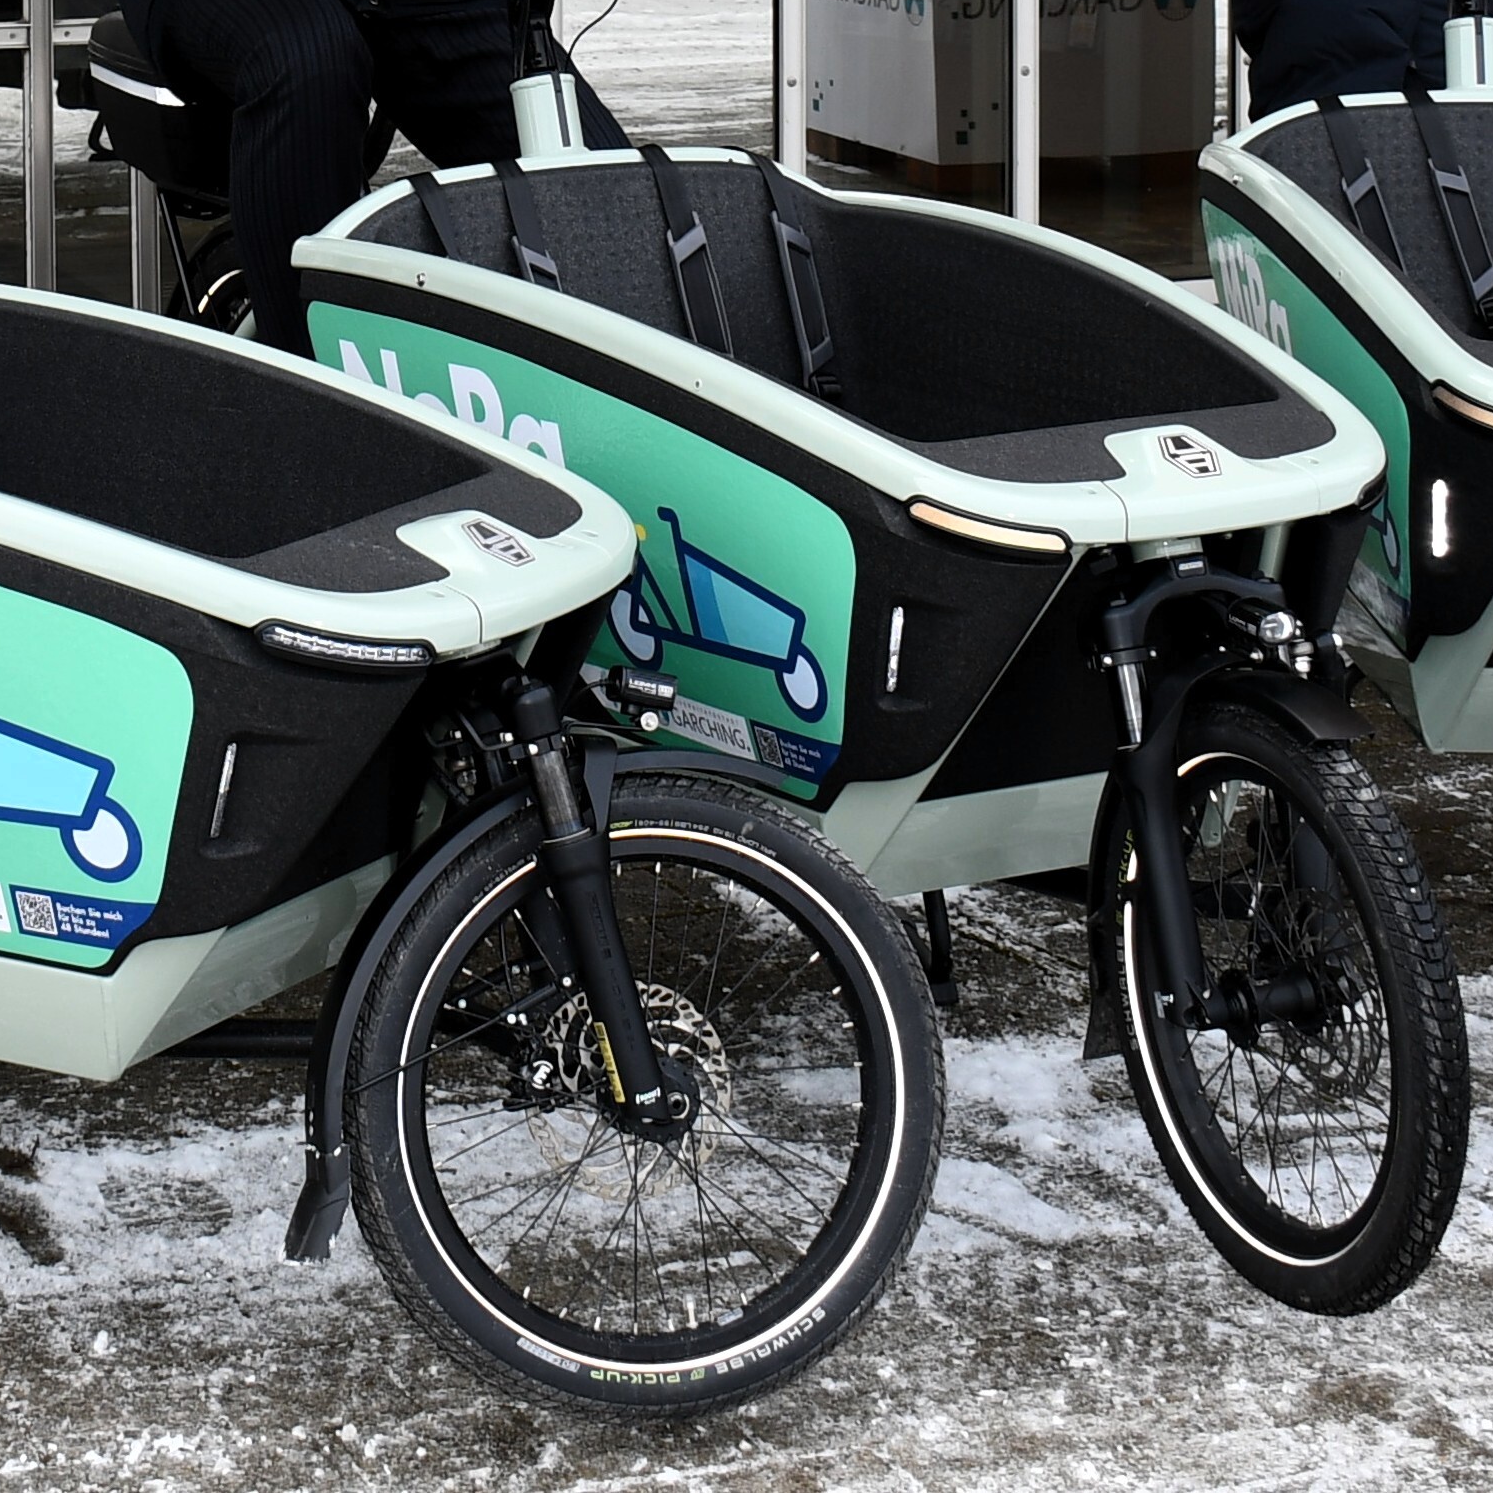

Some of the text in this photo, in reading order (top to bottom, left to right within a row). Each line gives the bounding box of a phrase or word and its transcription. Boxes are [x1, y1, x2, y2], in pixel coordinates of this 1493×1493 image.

[671, 706, 752, 753] GARCHING.
[715, 1306, 826, 1375] SCHWALBE
[590, 1369, 681, 1385] PICK-UP
